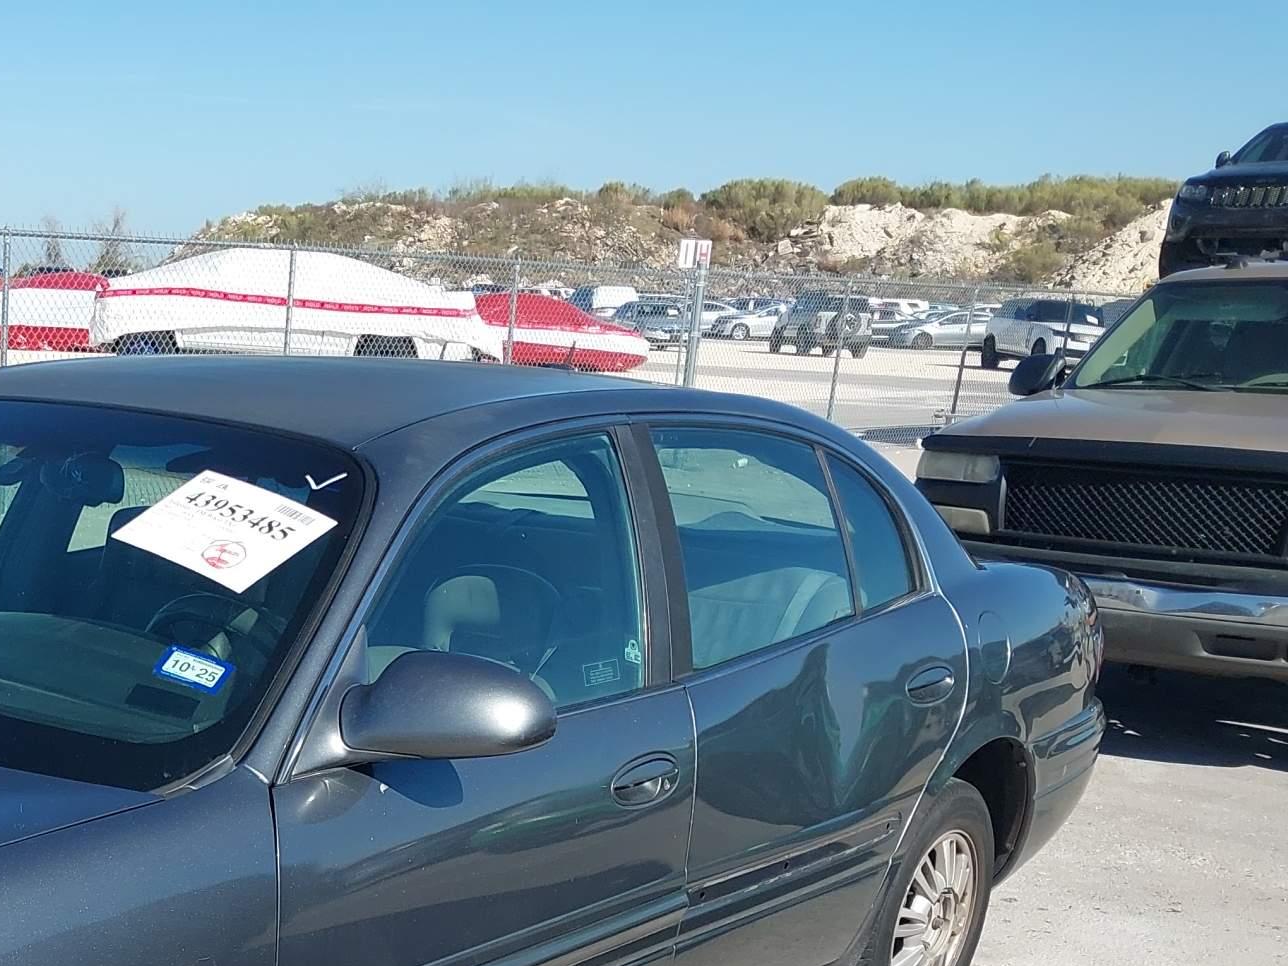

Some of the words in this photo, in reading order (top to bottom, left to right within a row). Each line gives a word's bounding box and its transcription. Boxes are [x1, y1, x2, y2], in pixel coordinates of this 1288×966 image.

[185, 490, 297, 541] 43953485
[171, 659, 191, 673] 10
[195, 667, 219, 683] 25
